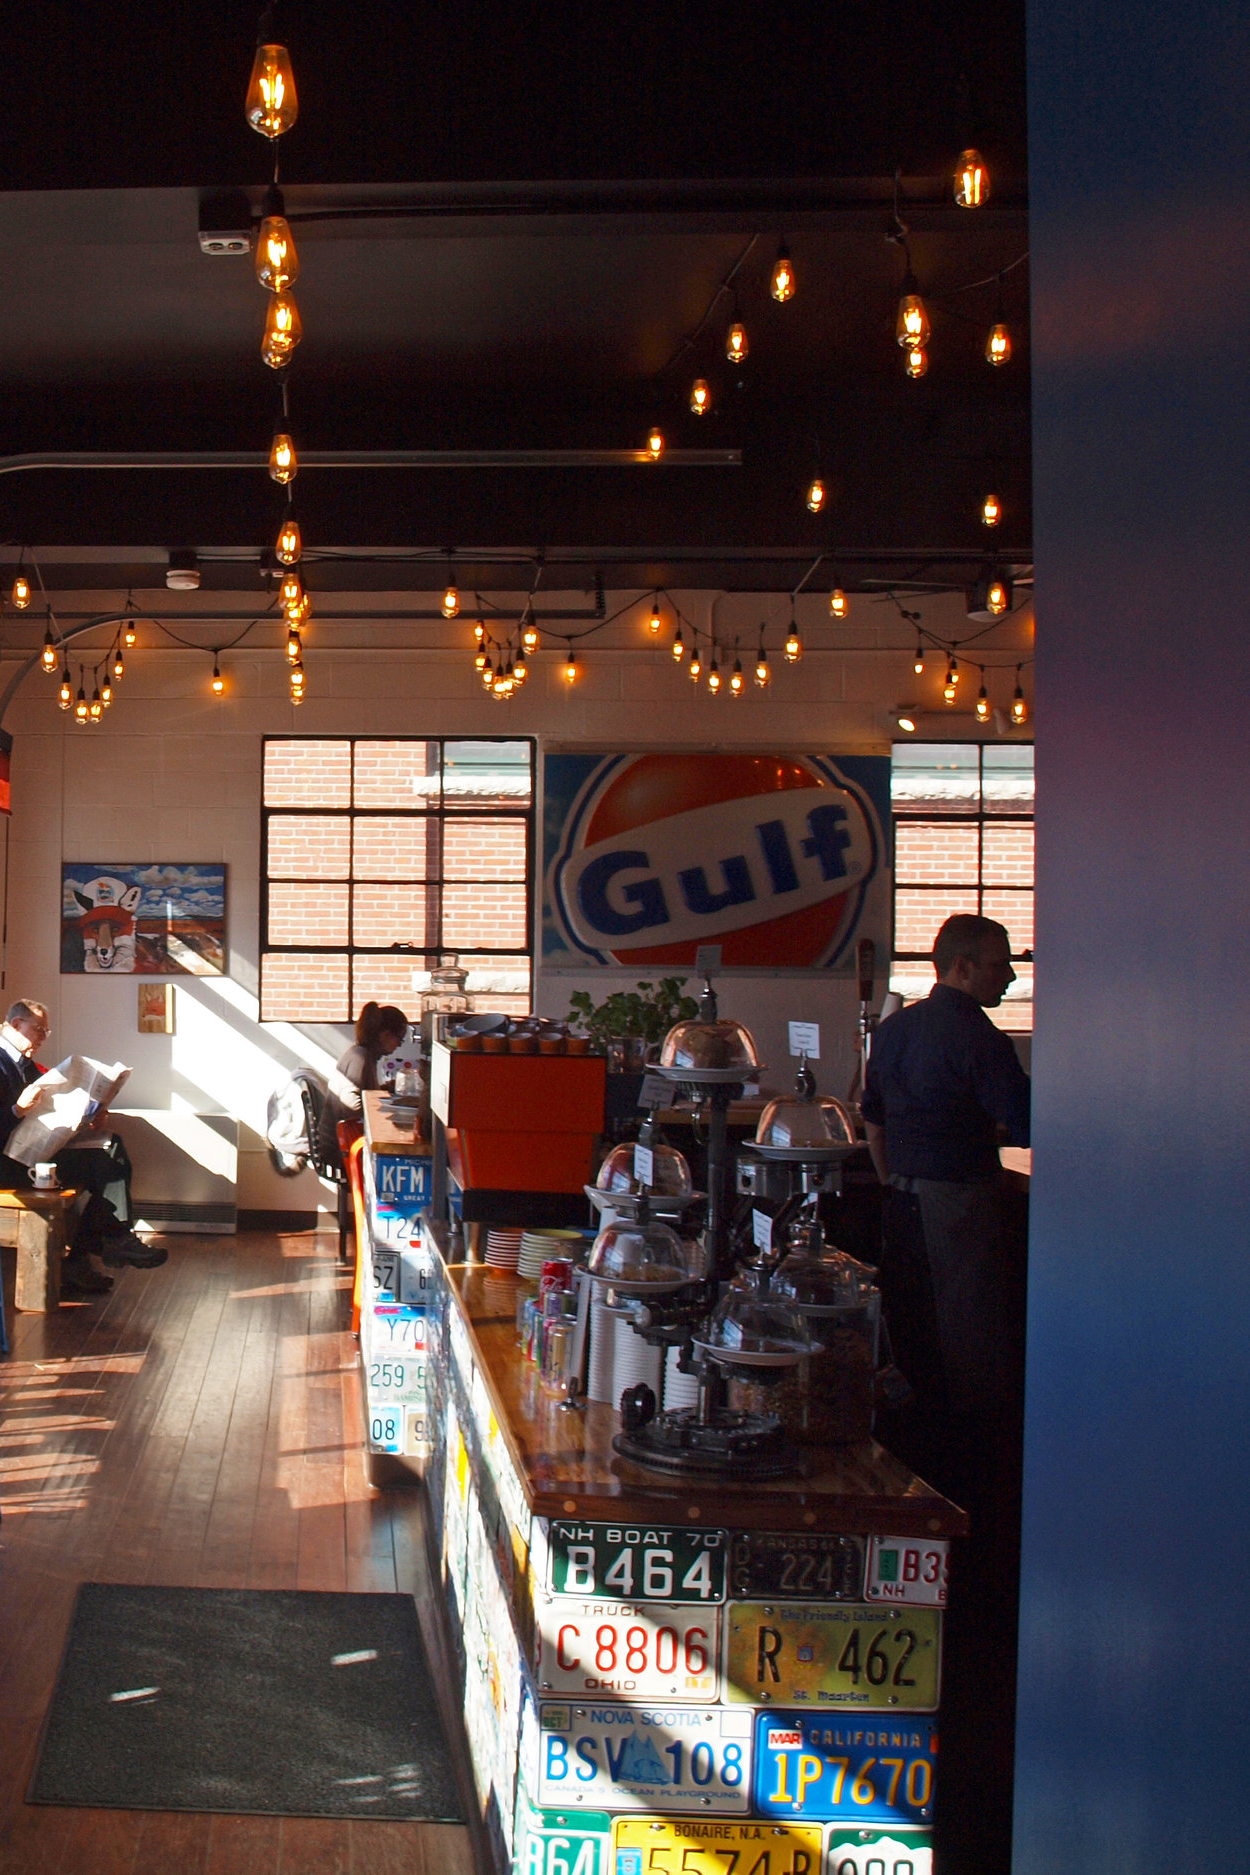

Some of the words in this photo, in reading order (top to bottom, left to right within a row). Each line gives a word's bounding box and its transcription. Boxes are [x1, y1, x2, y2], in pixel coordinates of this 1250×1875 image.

[577, 804, 851, 936] Gulf
[382, 1165, 425, 1193] KFM
[383, 1216, 421, 1239] T24
[387, 1318, 425, 1341] Y70
[371, 1363, 404, 1388] 259
[372, 1418, 395, 1441] 08
[559, 1527, 594, 1541] NH
[606, 1529, 672, 1545] BOAT
[686, 1533, 721, 1547] 70
[564, 1545, 712, 1598] B464
[779, 1552, 833, 1591] 224
[882, 1583, 905, 1598] NH
[582, 1604, 645, 1616] TRUCK
[757, 1626, 782, 1683] R
[838, 1628, 916, 1686] 462
[584, 1678, 637, 1690] OHIO
[591, 1709, 635, 1725] NOVA
[641, 1711, 701, 1727] SCOTIA
[769, 1732, 800, 1745] MAR
[810, 1730, 922, 1748] CALIFORNIA
[546, 1735, 629, 1783] BSV
[665, 1740, 743, 1787] 108
[769, 1753, 933, 1807] 1P7670
[612, 1787, 655, 1796] OCEAN
[660, 1789, 741, 1799] PLAYGROUND
[674, 1824, 735, 1841] BONAIRE,
[739, 1826, 766, 1840] N.A.
